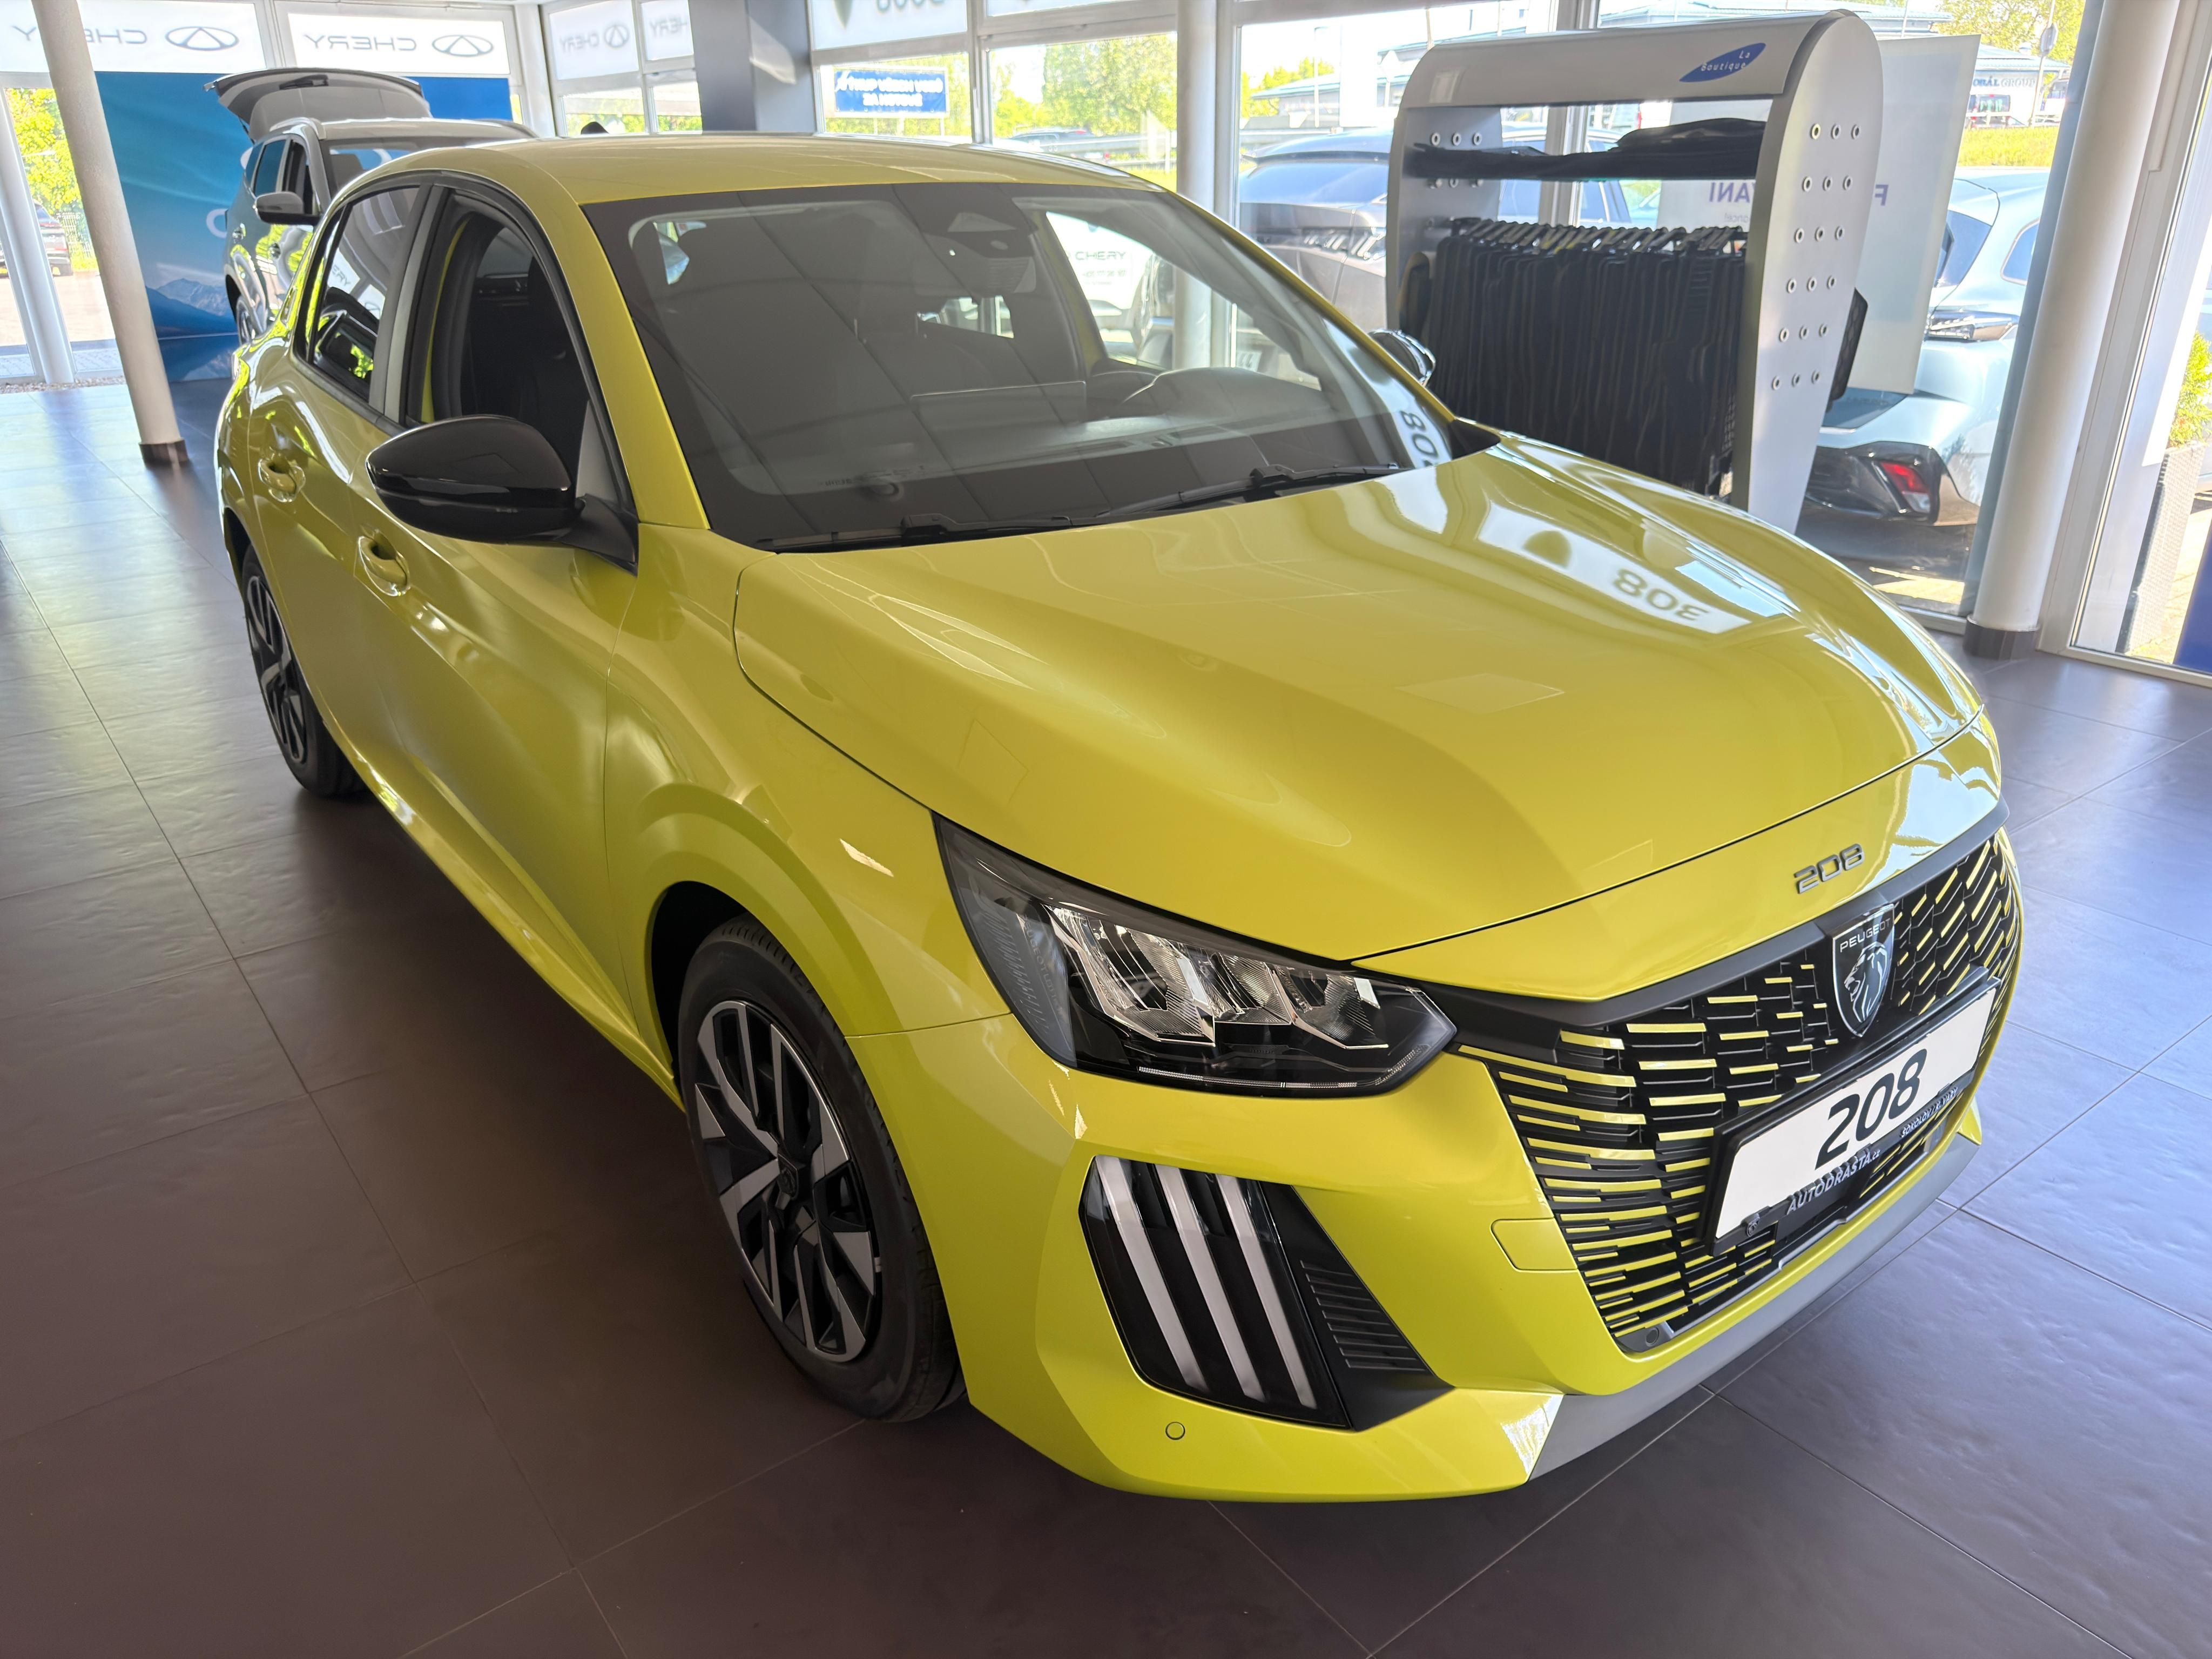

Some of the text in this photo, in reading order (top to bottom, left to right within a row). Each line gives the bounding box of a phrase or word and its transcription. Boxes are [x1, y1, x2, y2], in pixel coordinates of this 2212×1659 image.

[1701, 62, 1746, 72] Boutique
[1738, 50, 1750, 59] La
[1075, 251, 1127, 261] CHERY
[1793, 843, 1865, 894] 208
[1840, 918, 1891, 953] PEUGEOT
[1815, 1048, 1928, 1171] 208
[1900, 1108, 1932, 1138] SOKOLOV
[1943, 1086, 1959, 1105] VARY
[1786, 1149, 1881, 1216] AUTODRASTA.cz
